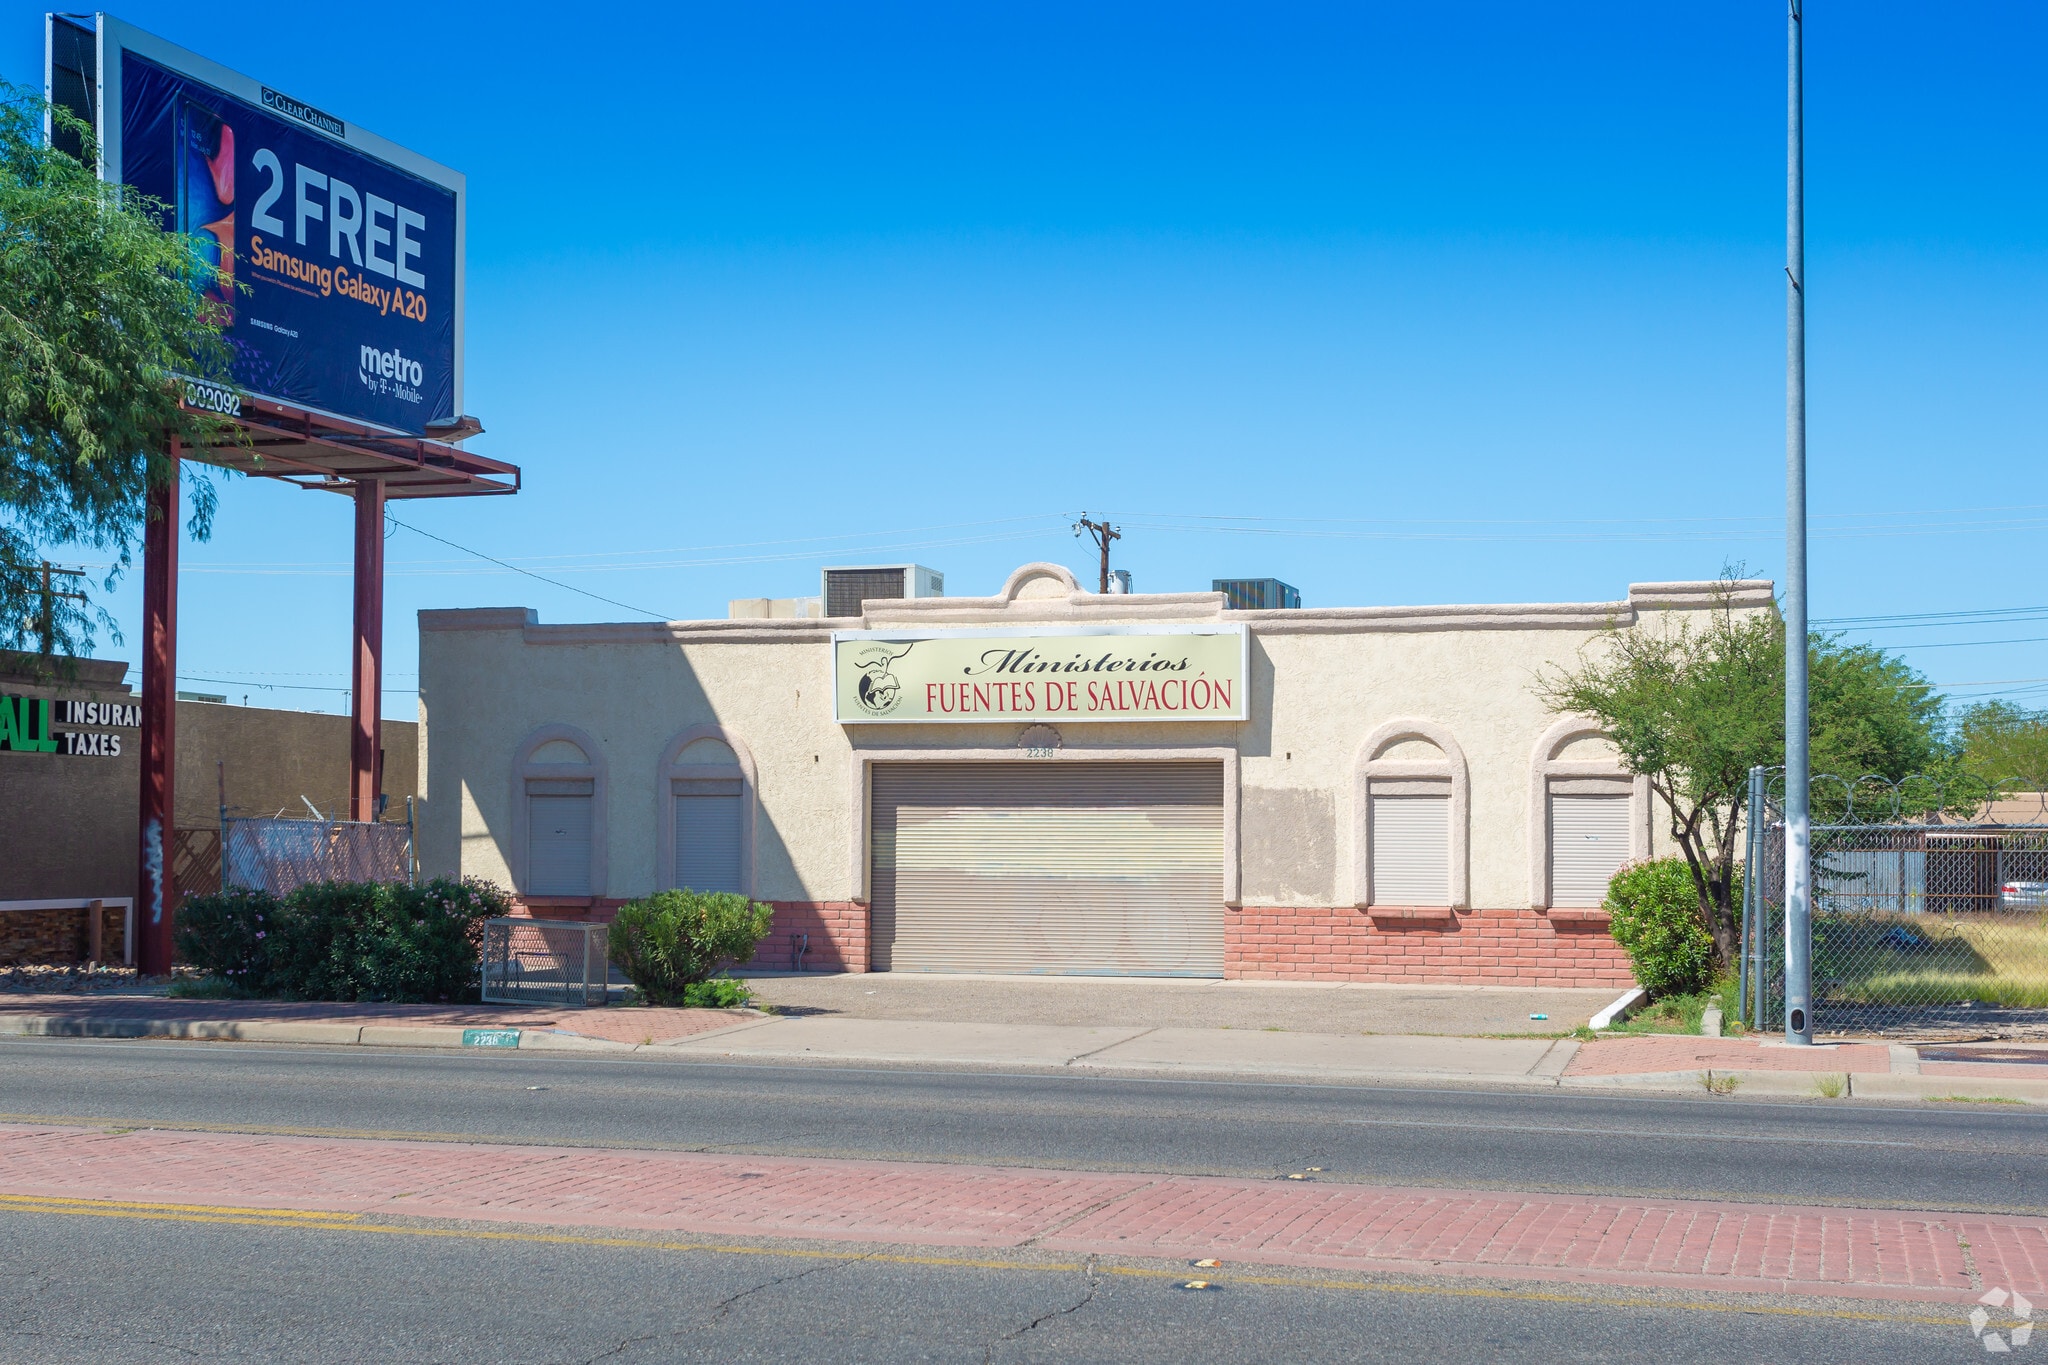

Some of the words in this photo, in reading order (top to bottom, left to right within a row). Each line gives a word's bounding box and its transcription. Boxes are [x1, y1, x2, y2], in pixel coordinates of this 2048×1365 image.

[251, 147, 284, 238] 2
[295, 162, 426, 290] FREE
[250, 235, 332, 297] Samsung
[334, 265, 391, 316] Galaxy
[391, 286, 427, 323] A20
[250, 317, 273, 331] SAMSUNG
[359, 344, 423, 387] metro
[368, 374, 379, 396] by
[859, 647, 895, 656] MINISTERIOS
[964, 646, 1192, 676] Ministerios
[925, 681, 1036, 713] FUENTES
[1045, 681, 1079, 712] DE
[1087, 670, 1233, 712] SALVACIÓN
[65, 732, 121, 757] TAXES
[1026, 748, 1054, 758] 2238
[473, 1035, 498, 1046] 2238
